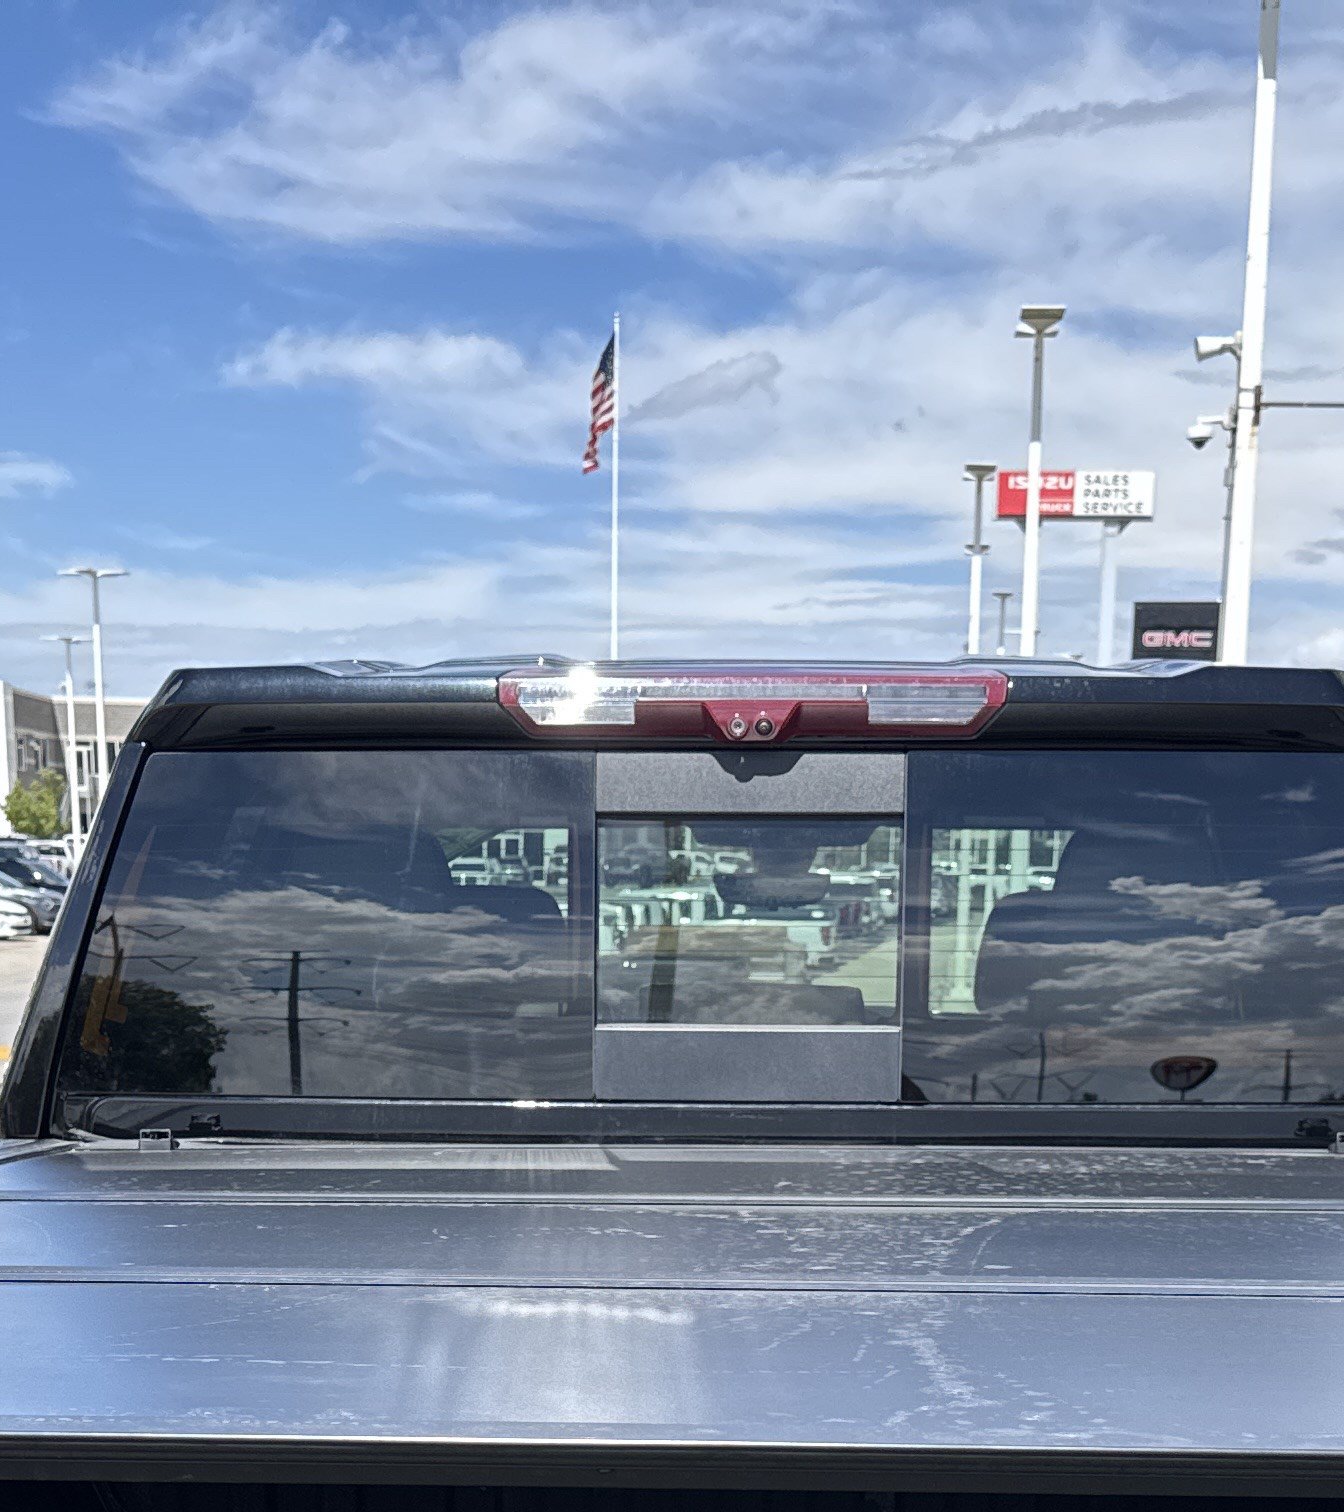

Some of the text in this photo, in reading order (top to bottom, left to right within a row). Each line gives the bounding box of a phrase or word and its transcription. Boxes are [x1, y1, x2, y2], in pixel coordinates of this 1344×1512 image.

[1084, 474, 1129, 486] SALES
[1083, 488, 1129, 499] PARTS
[1083, 502, 1144, 514] SERVICE
[1142, 629, 1214, 648] GMC
